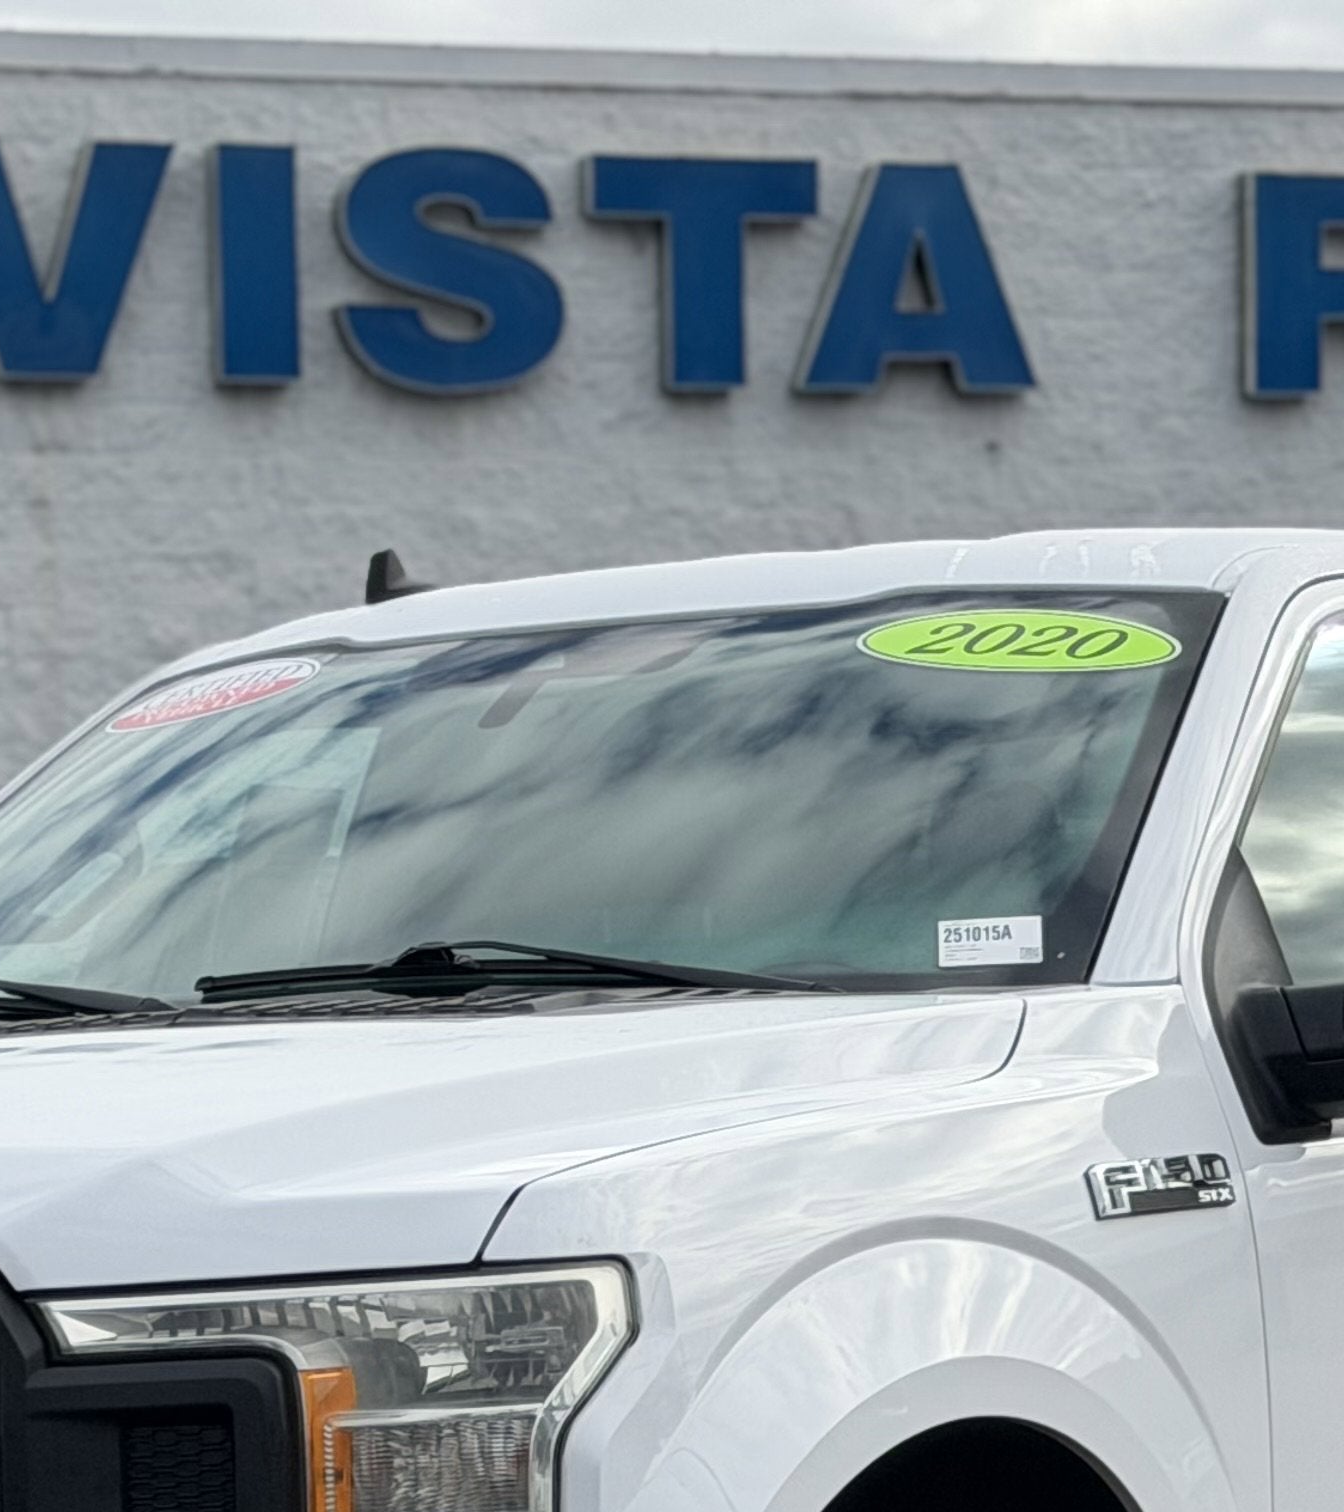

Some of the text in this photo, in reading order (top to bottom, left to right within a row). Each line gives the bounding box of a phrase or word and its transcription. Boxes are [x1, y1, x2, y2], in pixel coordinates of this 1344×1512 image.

[903, 622, 1130, 660] 2020
[943, 924, 1013, 943] 251015A
[1197, 1187, 1234, 1203] STX
